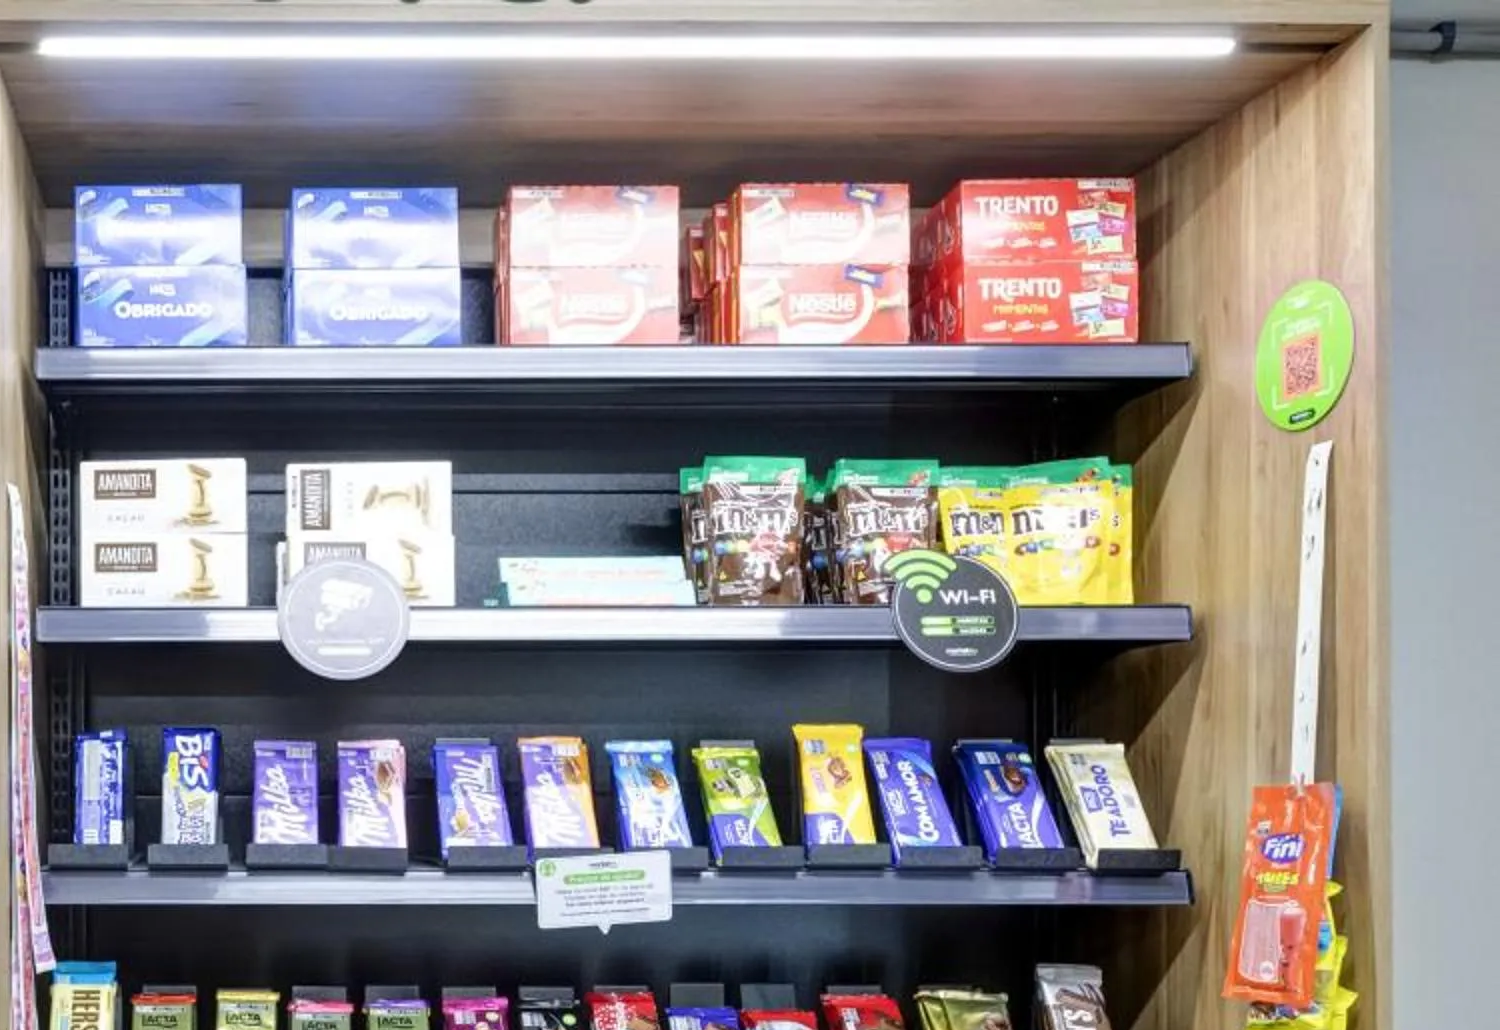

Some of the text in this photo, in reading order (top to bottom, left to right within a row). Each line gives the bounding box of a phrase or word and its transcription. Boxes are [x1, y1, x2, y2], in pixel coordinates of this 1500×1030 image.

[975, 196, 1059, 218] TRENTO
[978, 276, 1062, 300] TRENTO
[115, 300, 213, 319] OBRIGADO
[99, 473, 154, 492] AMANDITA
[304, 473, 324, 529] AMANDITA
[99, 546, 155, 567] AMANDITA
[938, 587, 997, 605] WI-FI
[175, 734, 210, 789] BIS
[897, 760, 941, 842] COM AMOR
[1263, 834, 1305, 860] Fini
[141, 1014, 178, 1028] LACTA
[224, 1012, 263, 1027] LACTA
[377, 1016, 414, 1028] LACTA
